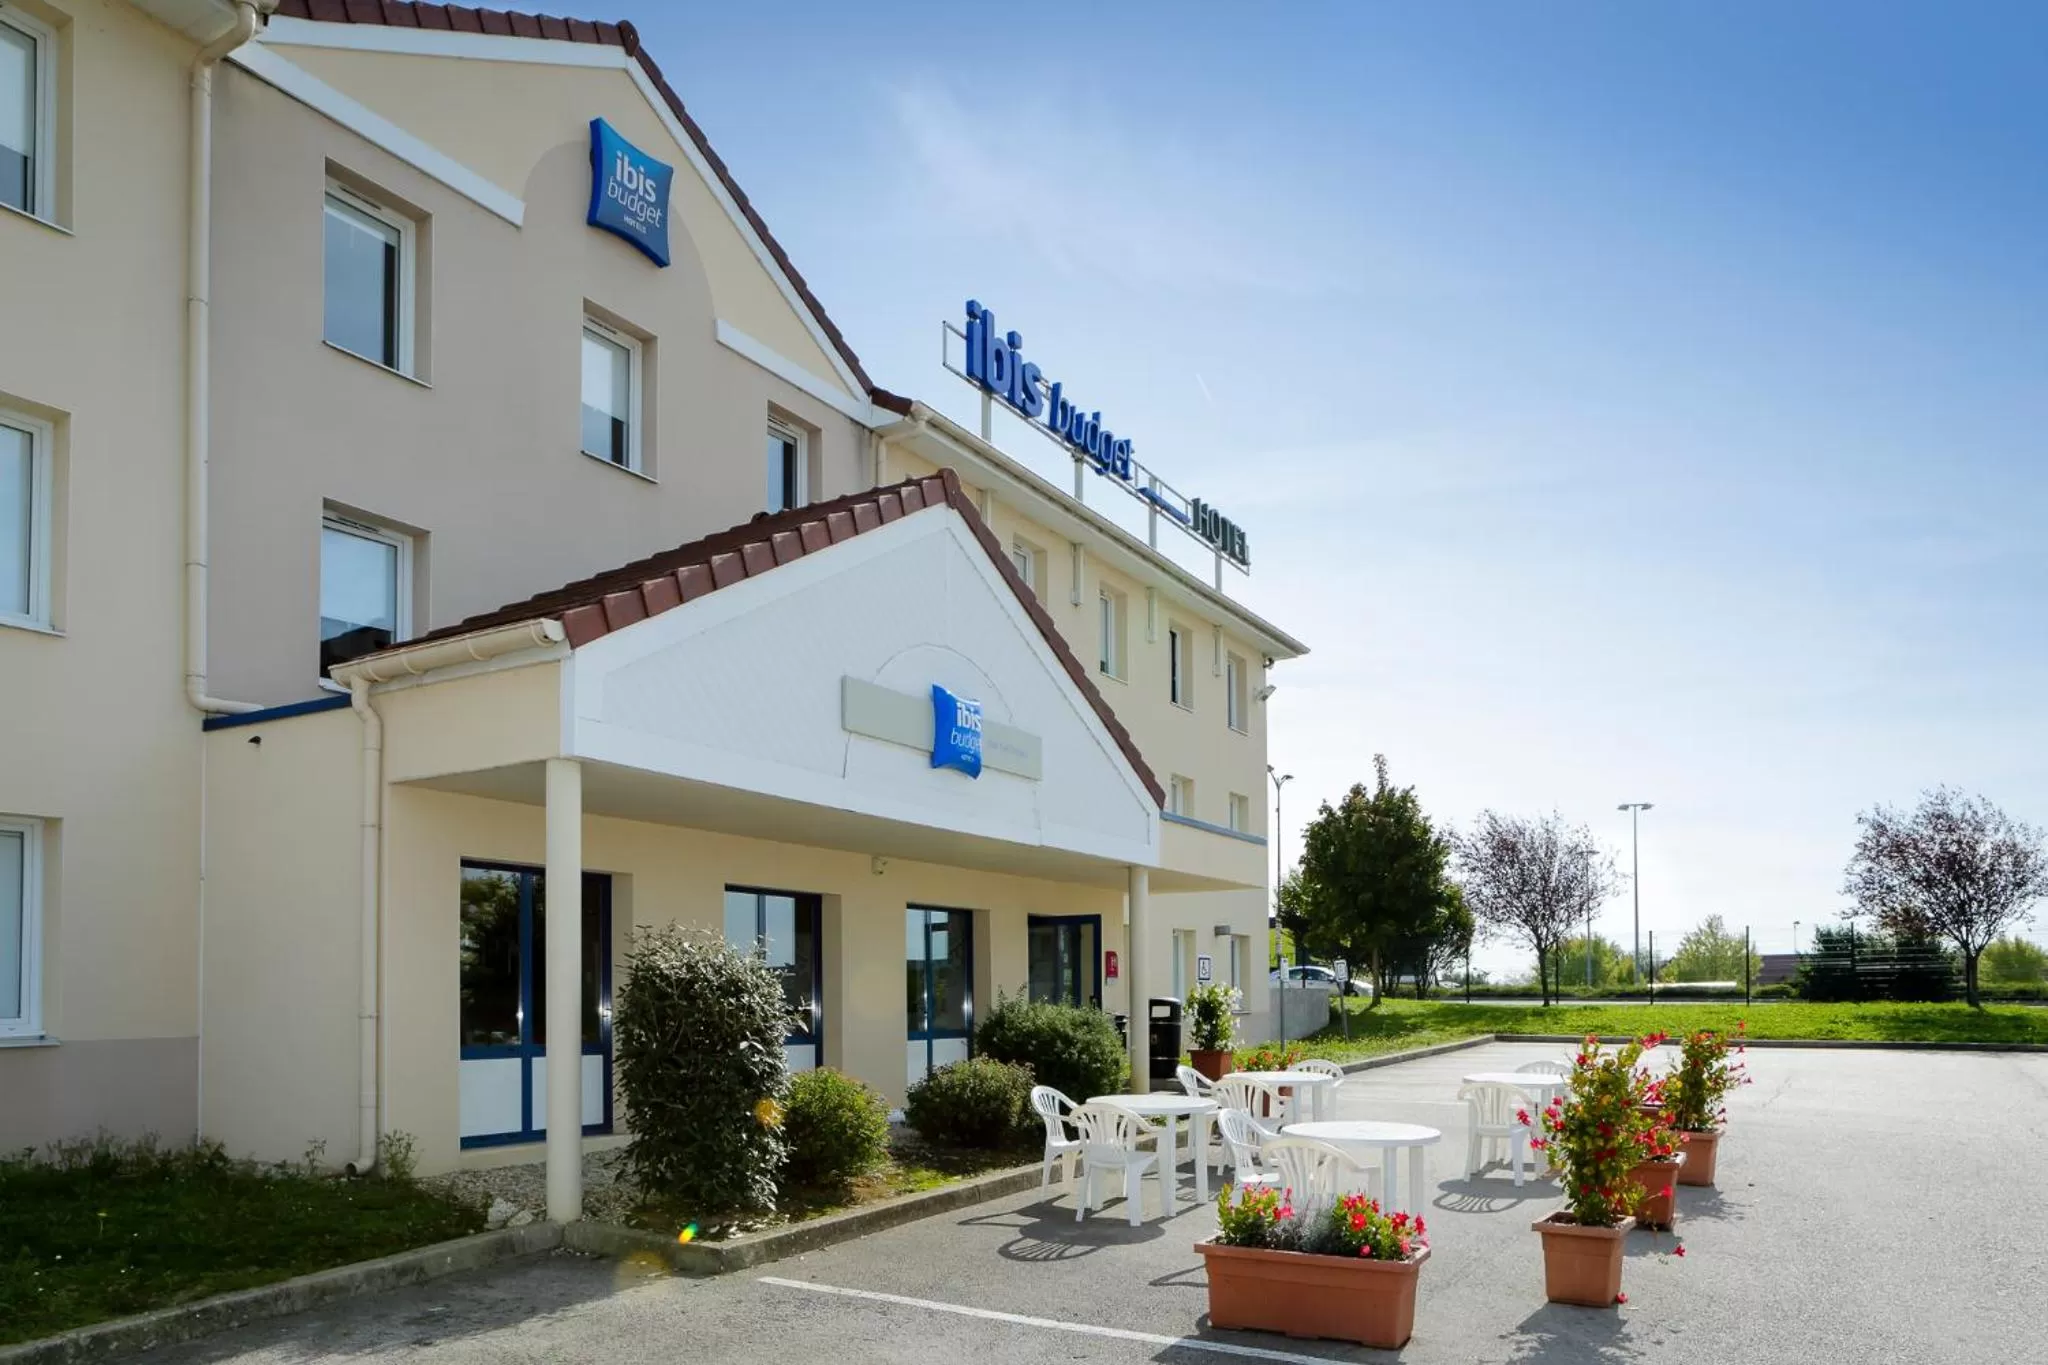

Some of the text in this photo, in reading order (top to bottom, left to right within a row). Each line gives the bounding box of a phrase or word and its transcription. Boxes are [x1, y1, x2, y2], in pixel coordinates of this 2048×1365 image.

[608, 176, 662, 228] budget
[616, 151, 656, 203] ibis
[966, 299, 1250, 566] ibis budget HOTEL
